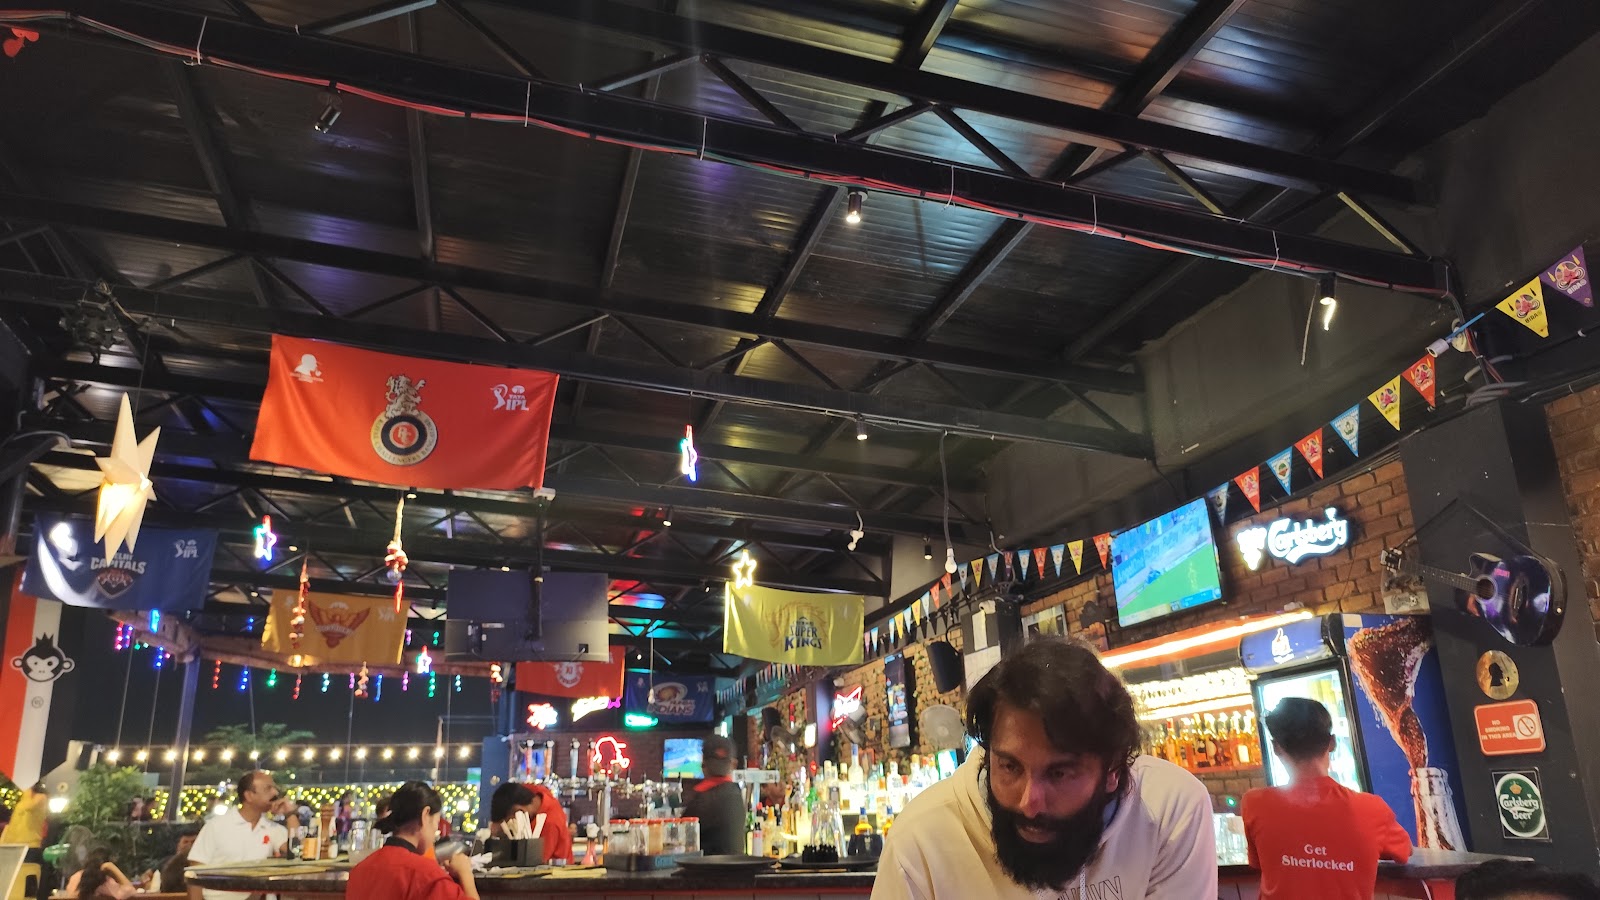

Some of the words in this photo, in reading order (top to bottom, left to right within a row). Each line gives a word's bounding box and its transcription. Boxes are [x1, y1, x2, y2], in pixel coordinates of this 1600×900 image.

[1525, 312, 1539, 323] BIRA
[506, 399, 529, 411] IPL
[1267, 513, 1348, 563] Carlsberg
[90, 557, 147, 575] CAPITALS
[790, 624, 818, 638] SUPER
[784, 636, 823, 652] KINGS
[1484, 725, 1510, 733] SMOKING
[1499, 793, 1539, 811] Carlsberg
[1511, 809, 1534, 820] Beer
[1303, 843, 1328, 856] Get
[1281, 854, 1354, 872] Sherlocked
